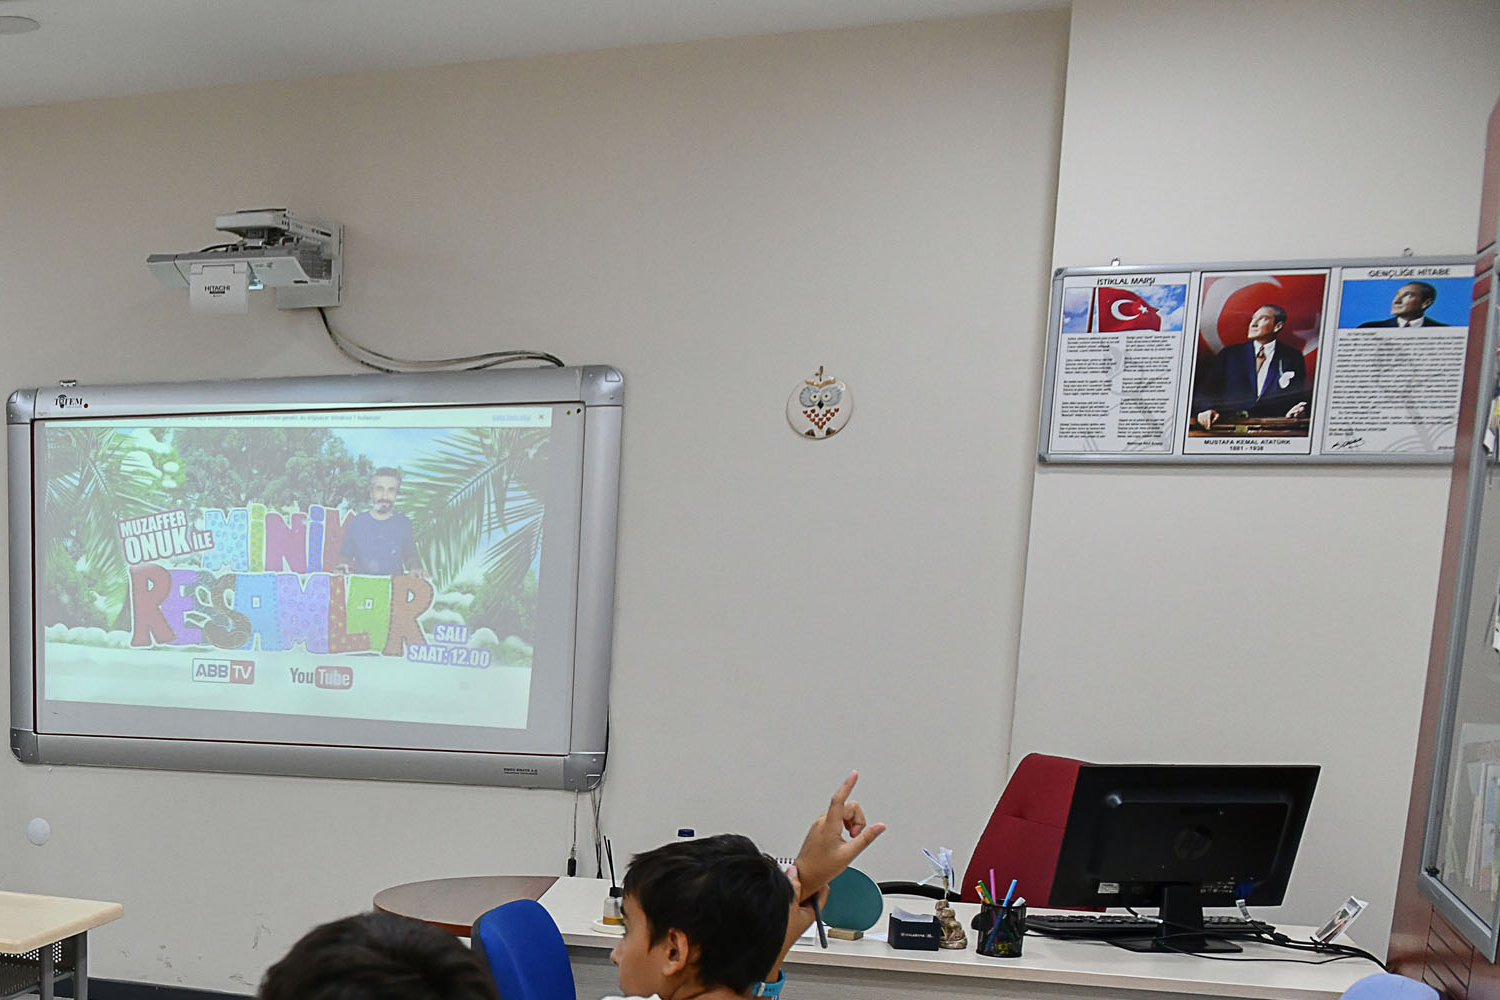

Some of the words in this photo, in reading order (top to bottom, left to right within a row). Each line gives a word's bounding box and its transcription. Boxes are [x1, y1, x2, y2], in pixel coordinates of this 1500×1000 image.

[121, 511, 186, 538] MUZAFFER
[125, 525, 191, 564] ONUK
[193, 531, 213, 551] İLE
[436, 625, 468, 643] SALI
[409, 645, 448, 664] SAAT:
[450, 649, 490, 667] 12.00
[290, 667, 351, 688] YouTube
